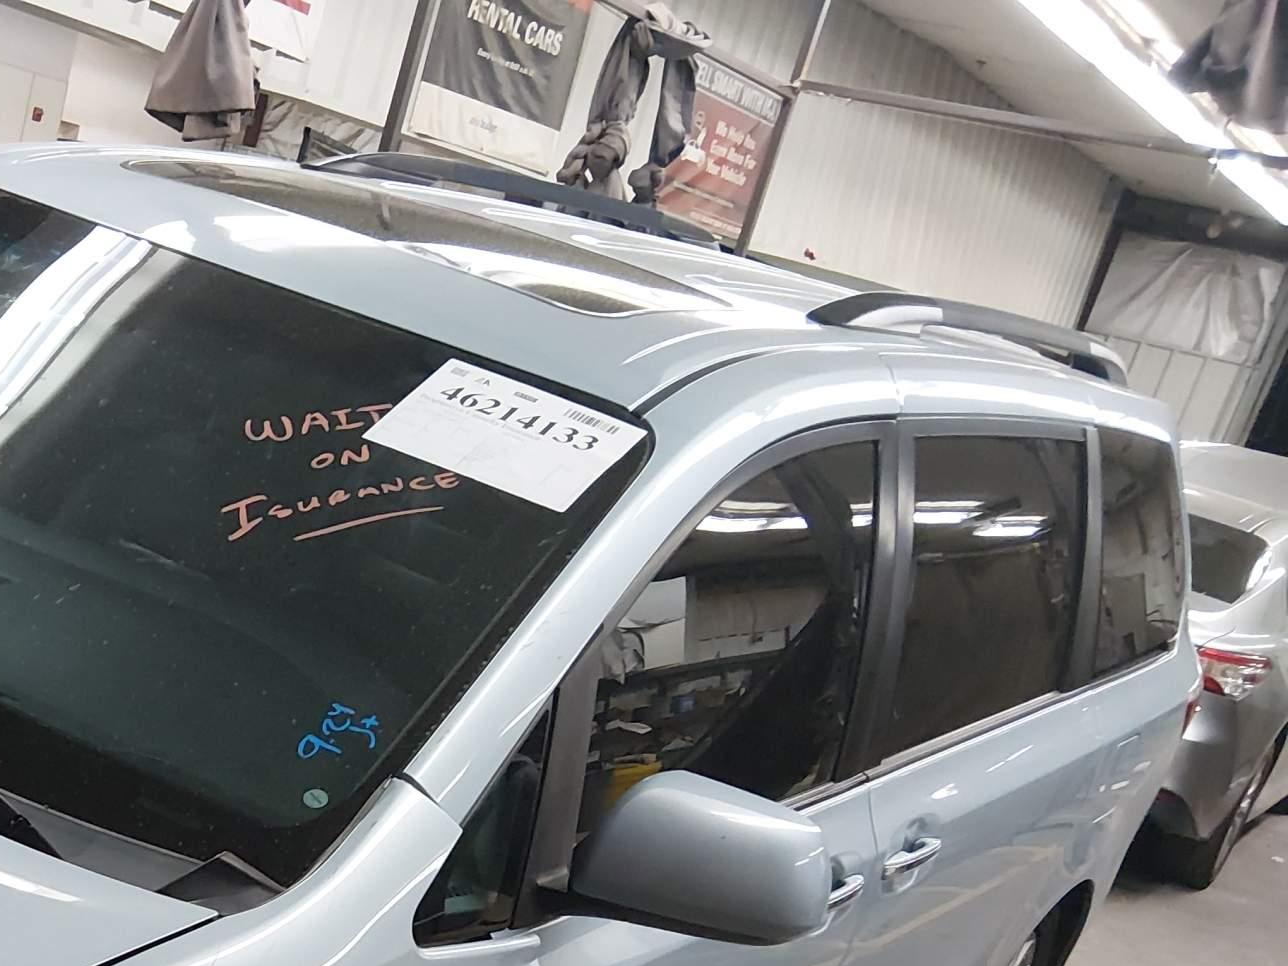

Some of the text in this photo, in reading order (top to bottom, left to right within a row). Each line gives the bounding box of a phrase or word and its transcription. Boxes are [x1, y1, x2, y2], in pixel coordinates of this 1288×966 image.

[466, 0, 564, 57] RENTAL CARS
[695, 59, 713, 89] ELL
[244, 403, 393, 442] WAIT
[440, 387, 599, 451] 46214133
[310, 443, 371, 469] ON
